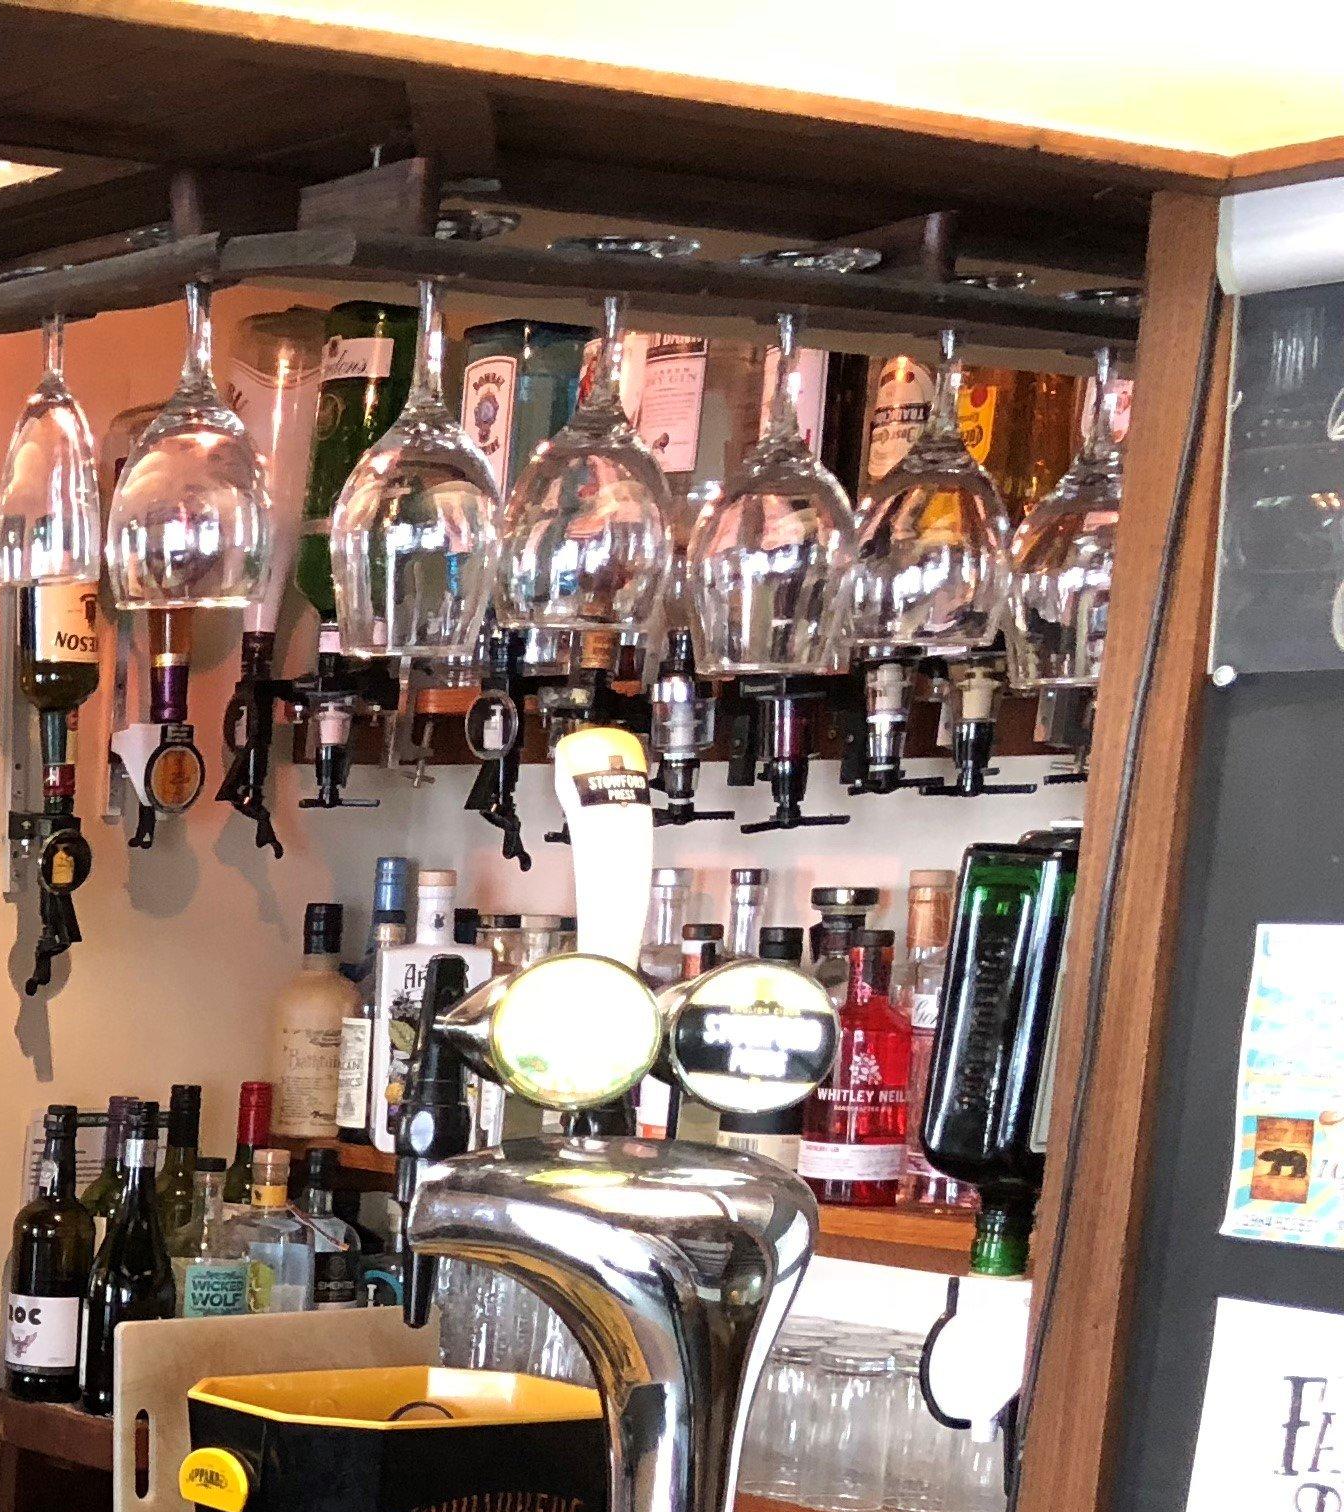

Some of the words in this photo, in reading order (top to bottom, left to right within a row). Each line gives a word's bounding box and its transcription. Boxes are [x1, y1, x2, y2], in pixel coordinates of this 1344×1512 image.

[55, 631, 98, 653] ESON
[817, 1087, 875, 1103] WHITLEY
[191, 1280, 244, 1293] WICKED
[191, 1292, 240, 1308] WOLF
